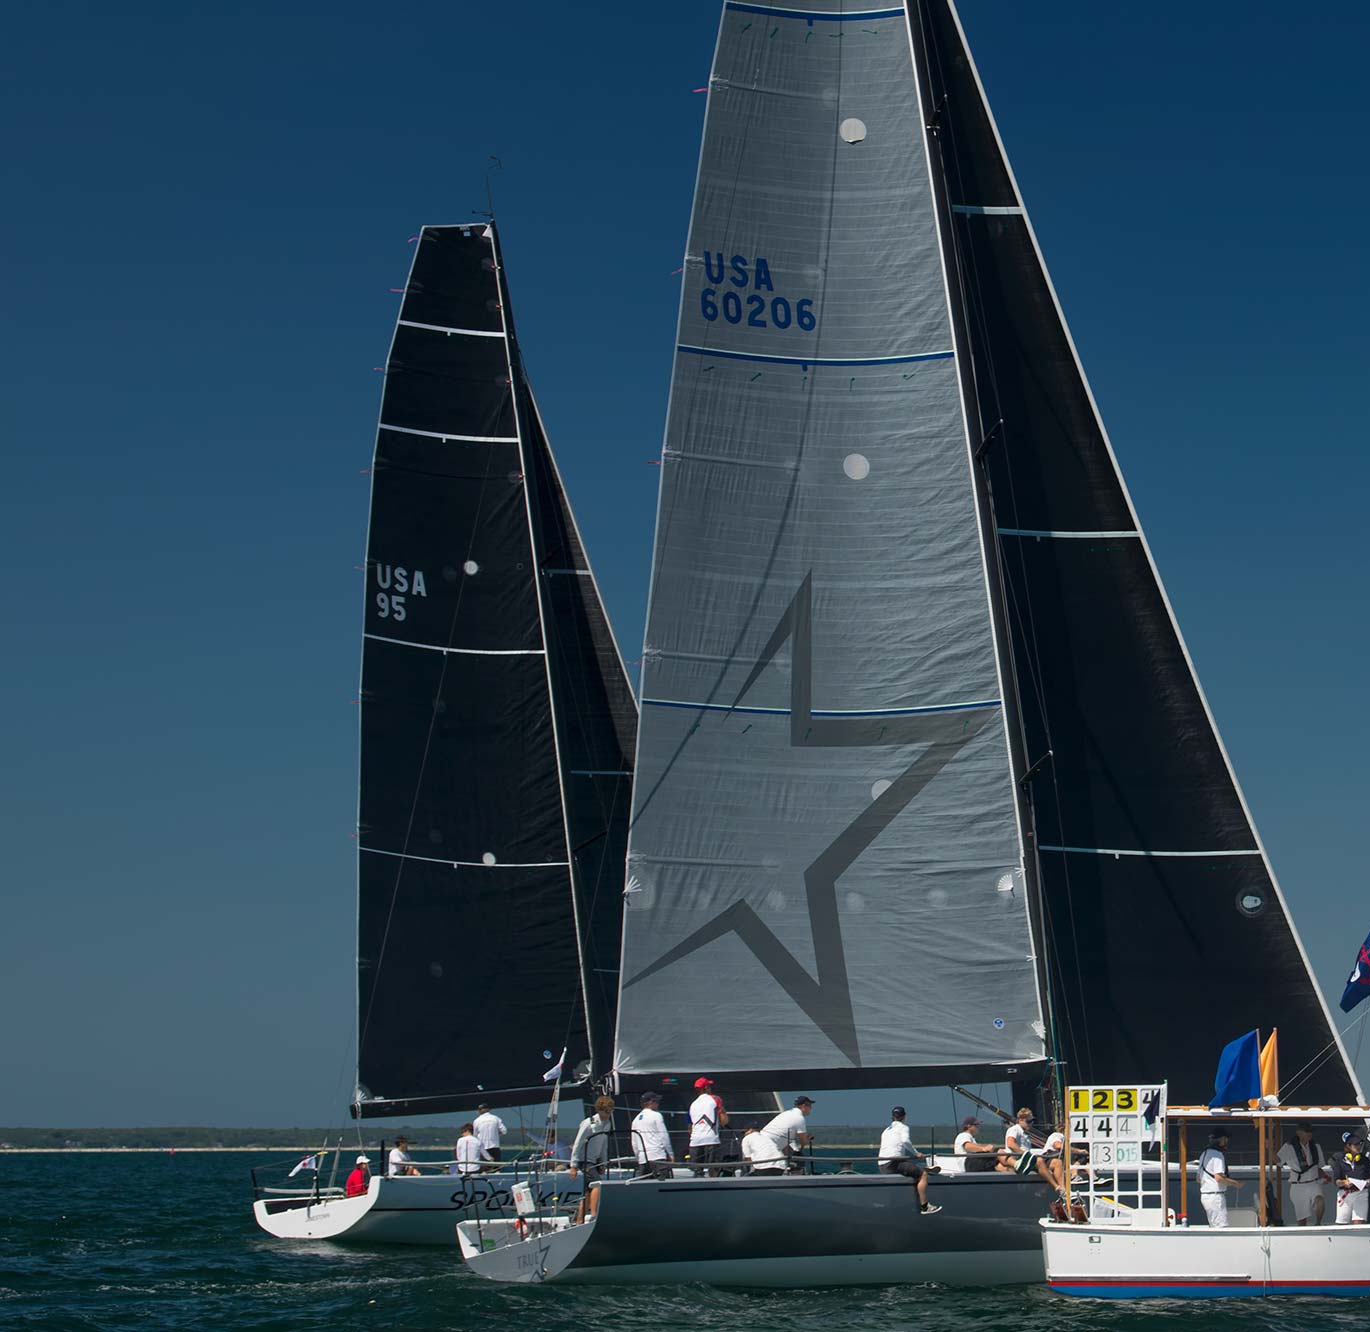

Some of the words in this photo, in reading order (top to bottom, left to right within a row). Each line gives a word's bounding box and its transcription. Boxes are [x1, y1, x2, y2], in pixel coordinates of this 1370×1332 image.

[703, 250, 774, 291] USA
[701, 288, 816, 331] 60206
[376, 563, 427, 597] USA
[376, 592, 406, 621] 95
[1073, 1092, 1080, 1109] 1
[1093, 1091, 1109, 1109] 2
[1117, 1091, 1133, 1109] 3
[1074, 1118, 1088, 1137] 4
[1097, 1118, 1112, 1137] 4
[1120, 1118, 1131, 1134] 4
[449, 1191, 583, 1211] SPOKIE
[516, 1251, 540, 1270] TRUE
